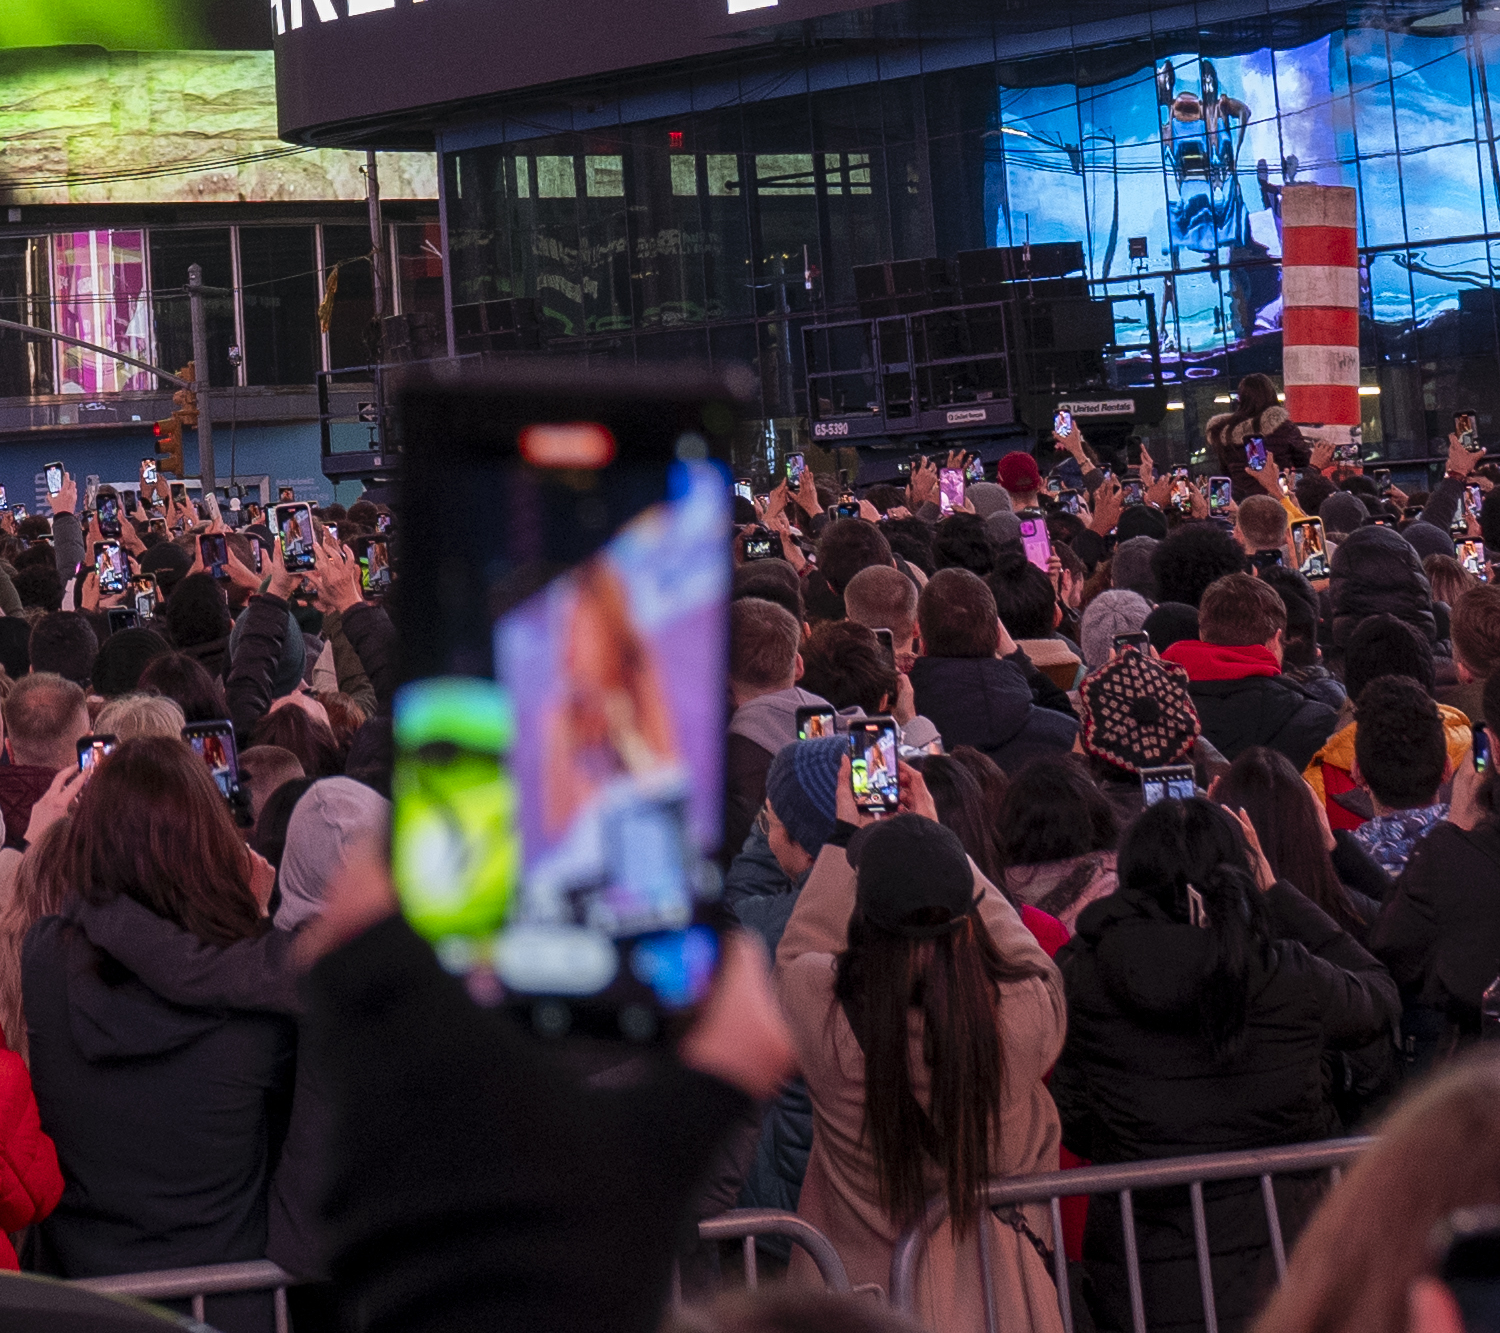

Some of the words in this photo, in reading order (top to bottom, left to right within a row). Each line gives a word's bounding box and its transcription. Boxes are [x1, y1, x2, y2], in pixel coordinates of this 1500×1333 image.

[1072, 403, 1100, 414] United
[1101, 401, 1131, 413] Rentals
[814, 422, 849, 437] GS-5390
